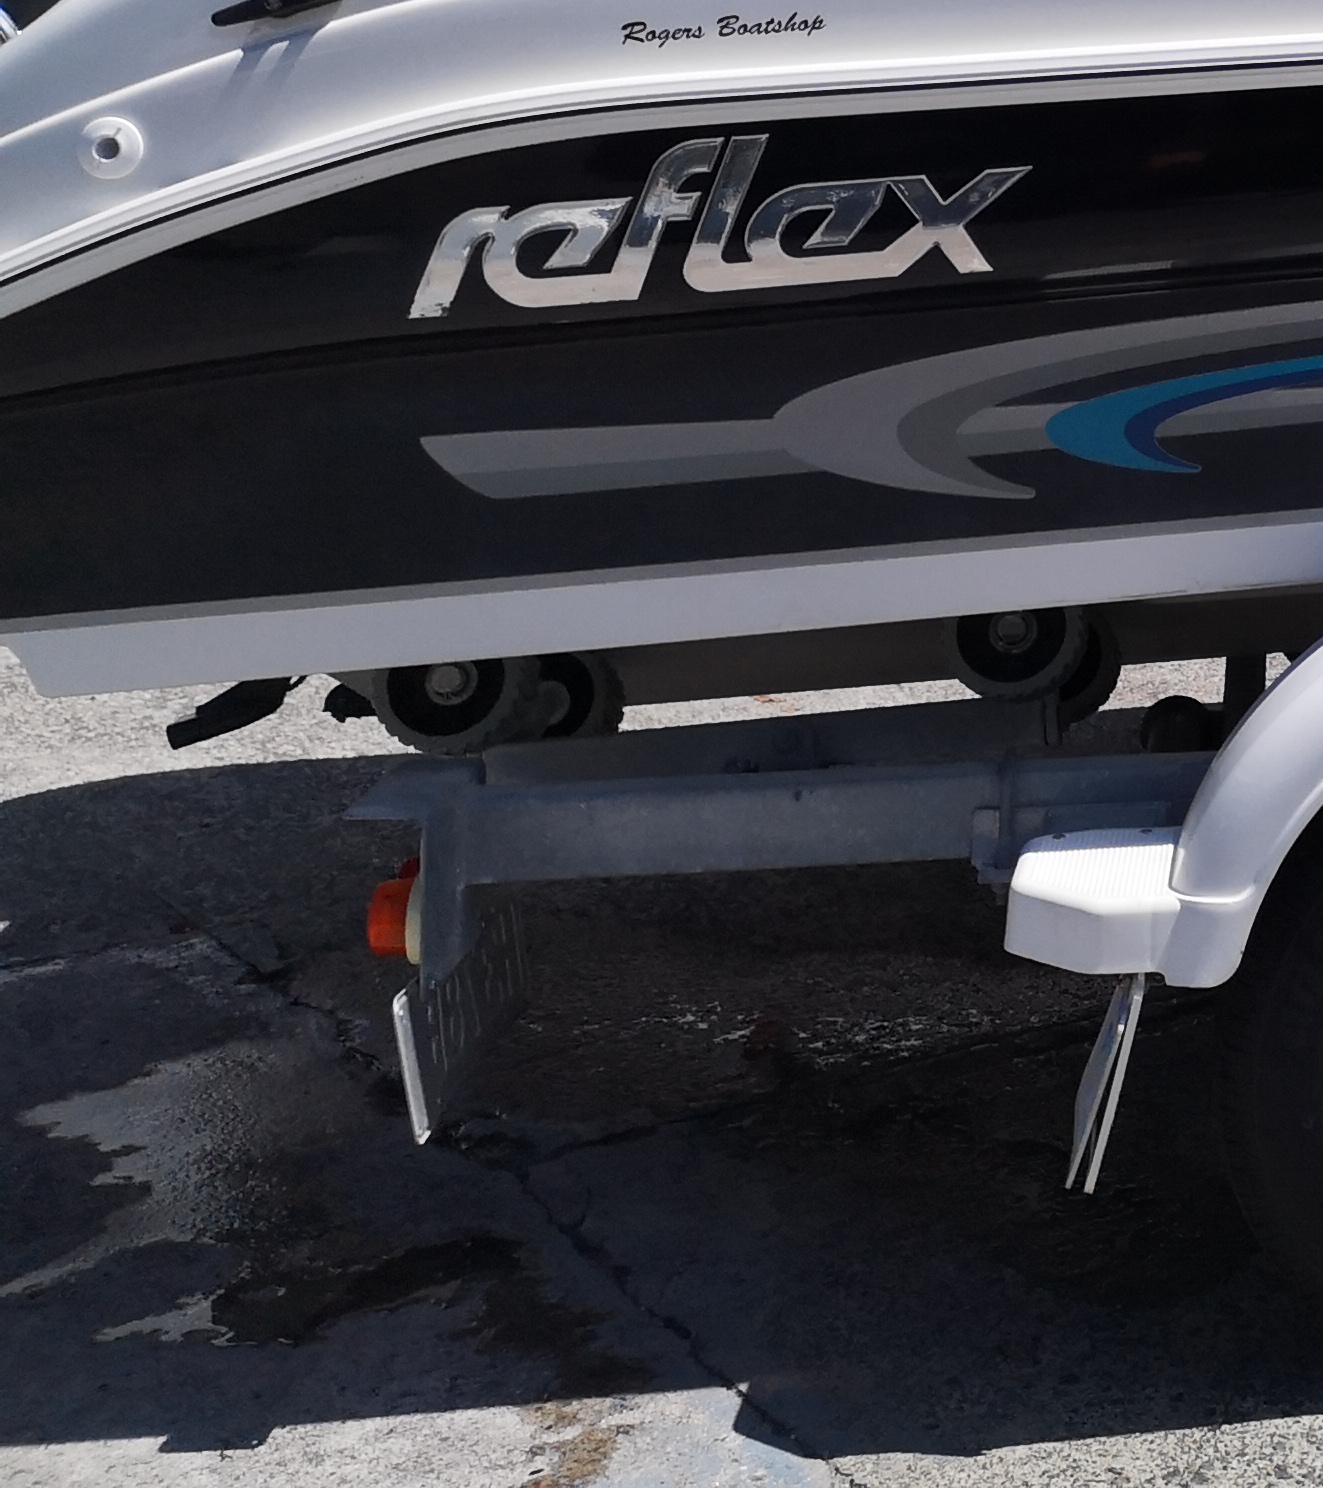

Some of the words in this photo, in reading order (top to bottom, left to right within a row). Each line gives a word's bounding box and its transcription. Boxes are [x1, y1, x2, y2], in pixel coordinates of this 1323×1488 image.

[621, 20, 706, 49] Rogers
[716, 11, 827, 42] Boatshop
[406, 132, 1034, 321] reflex
